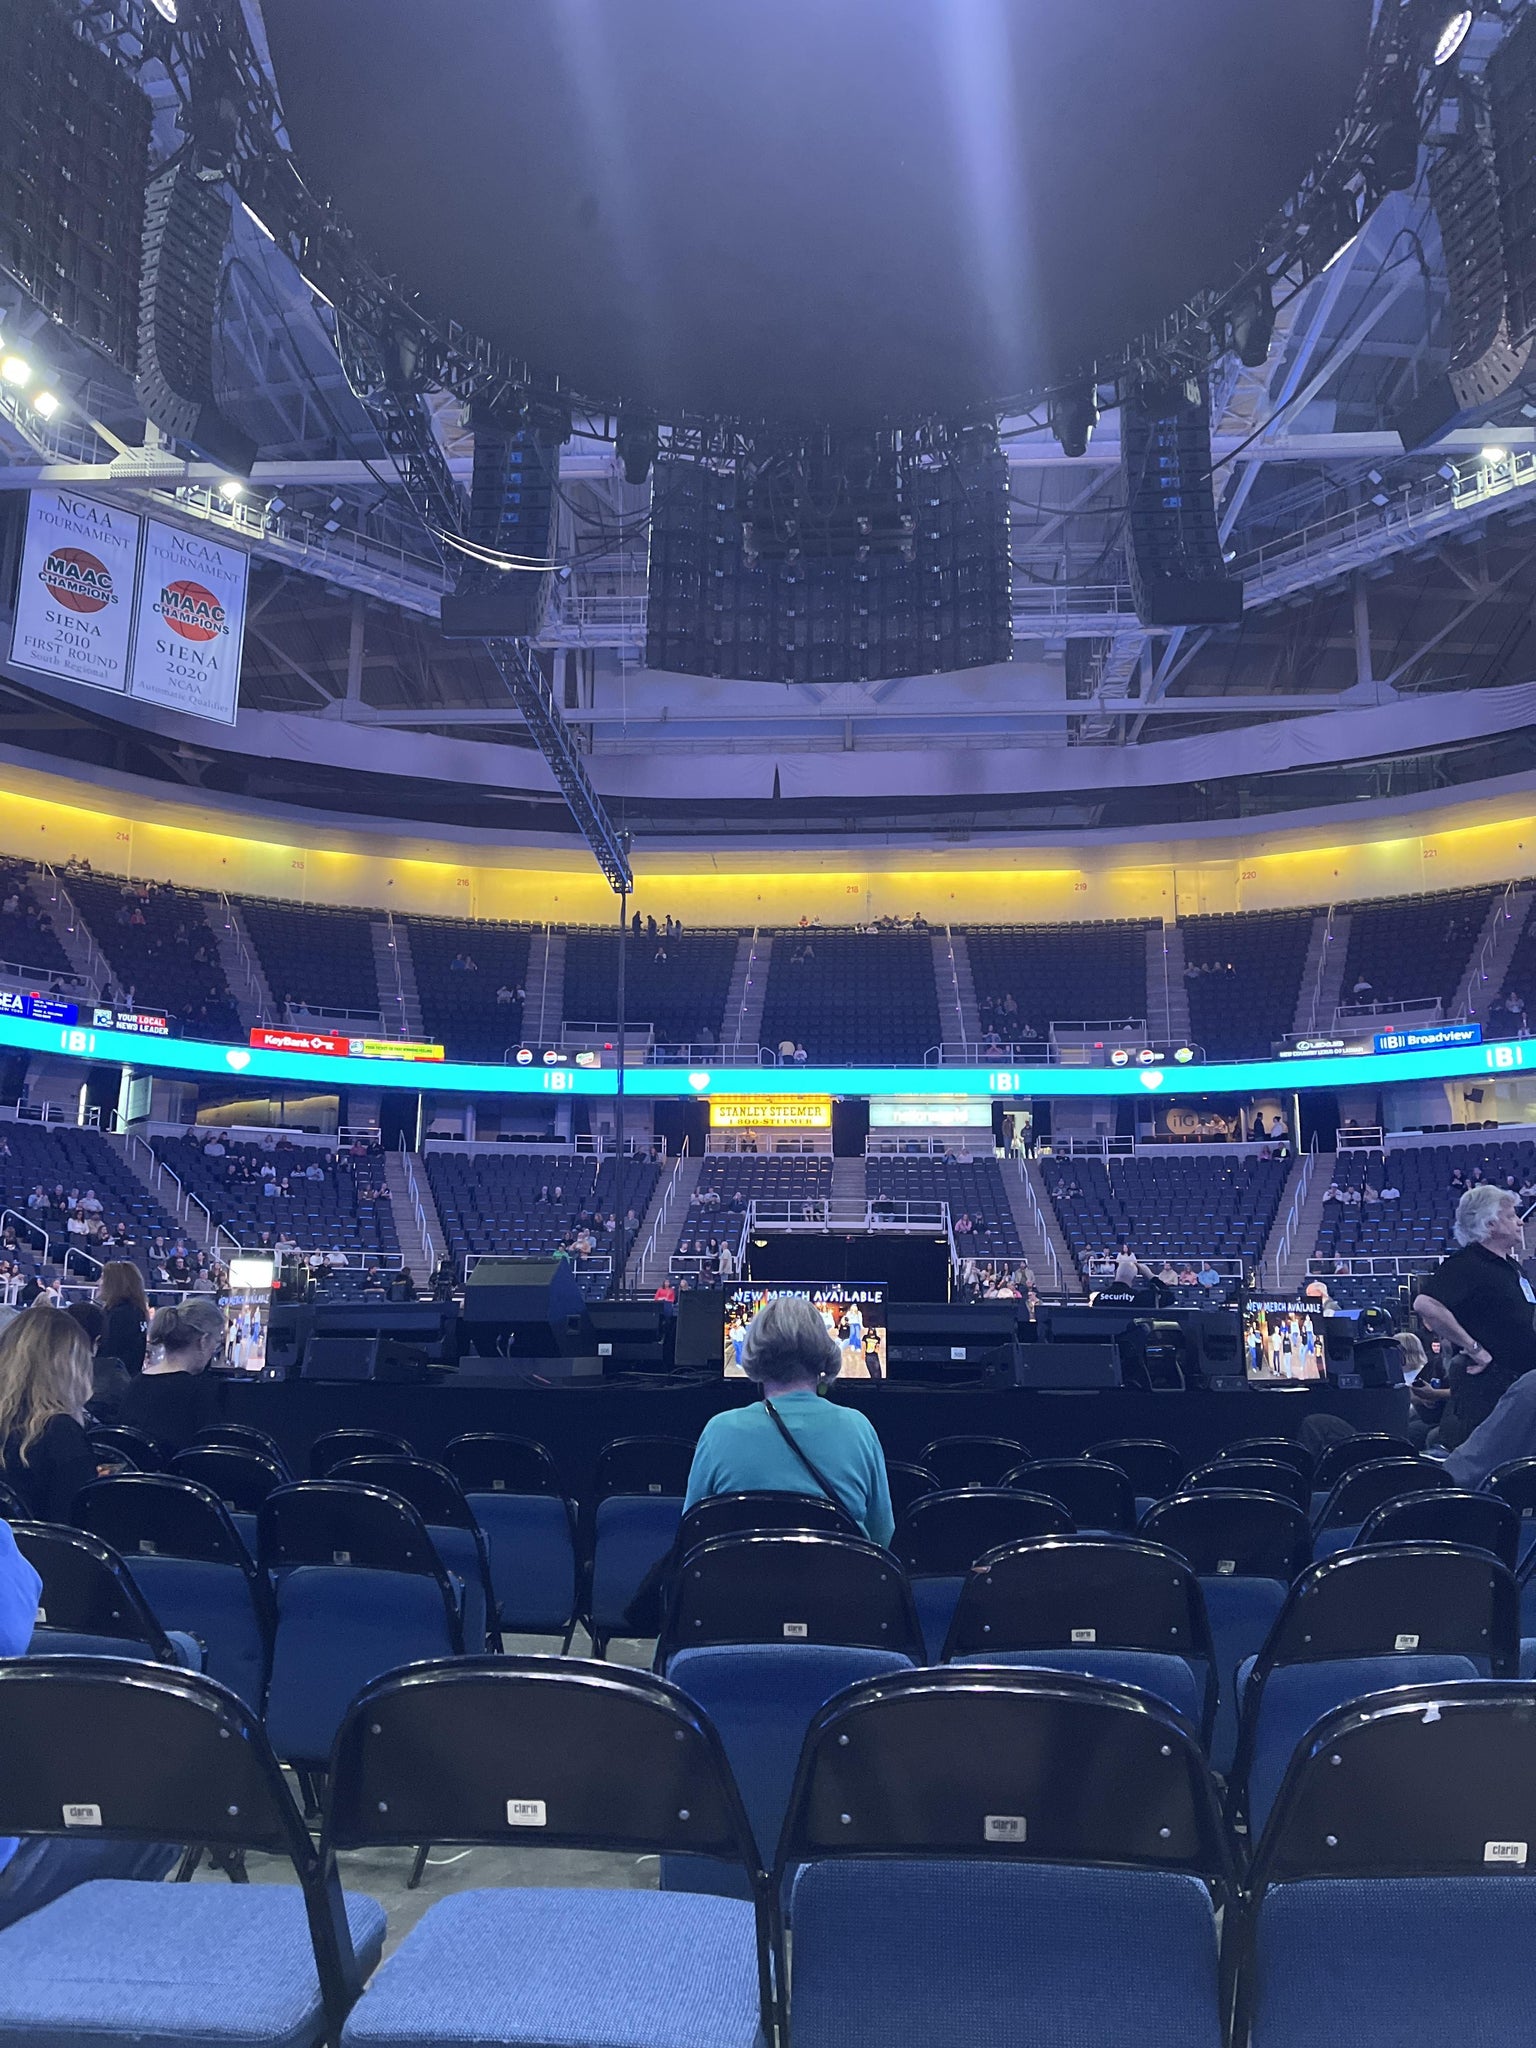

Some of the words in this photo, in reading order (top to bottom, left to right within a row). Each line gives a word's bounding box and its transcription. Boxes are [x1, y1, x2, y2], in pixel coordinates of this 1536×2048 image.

[57, 495, 112, 528] NCAA
[37, 508, 130, 549] TOURNAMENT
[172, 535, 222, 565] NCAA
[46, 556, 113, 589] MAAC
[152, 545, 240, 584] TOURNAMENT
[38, 571, 119, 605] CHAMPIONS
[160, 587, 226, 622] MAAC
[45, 610, 102, 637] SIENA
[152, 603, 230, 635] CHAMPIONS
[54, 629, 91, 650] 2010
[24, 635, 63, 654] FIRST
[68, 647, 118, 670] ROUND
[156, 639, 218, 670] SIENA
[30, 650, 60, 665] South
[64, 660, 108, 679] Regional
[166, 661, 208, 682] 2020
[168, 677, 202, 695] NCAA
[0, 992, 24, 1010] EA
[116, 1021, 138, 1031] NEWS
[139, 1024, 169, 1035] LEADER
[117, 1012, 138, 1022] YOUR
[138, 1015, 164, 1026] LOCAL
[264, 1034, 310, 1048] KeyBank
[1407, 1031, 1473, 1045] Broadview
[719, 1106, 767, 1117] STANLEY
[769, 1106, 822, 1117] STEEMER
[733, 1291, 763, 1302] NEW
[813, 1290, 883, 1303] AVAILABLE
[1100, 1293, 1135, 1302] Security
[513, 1802, 538, 1814] clarin
[1492, 1844, 1519, 1855] clarin
